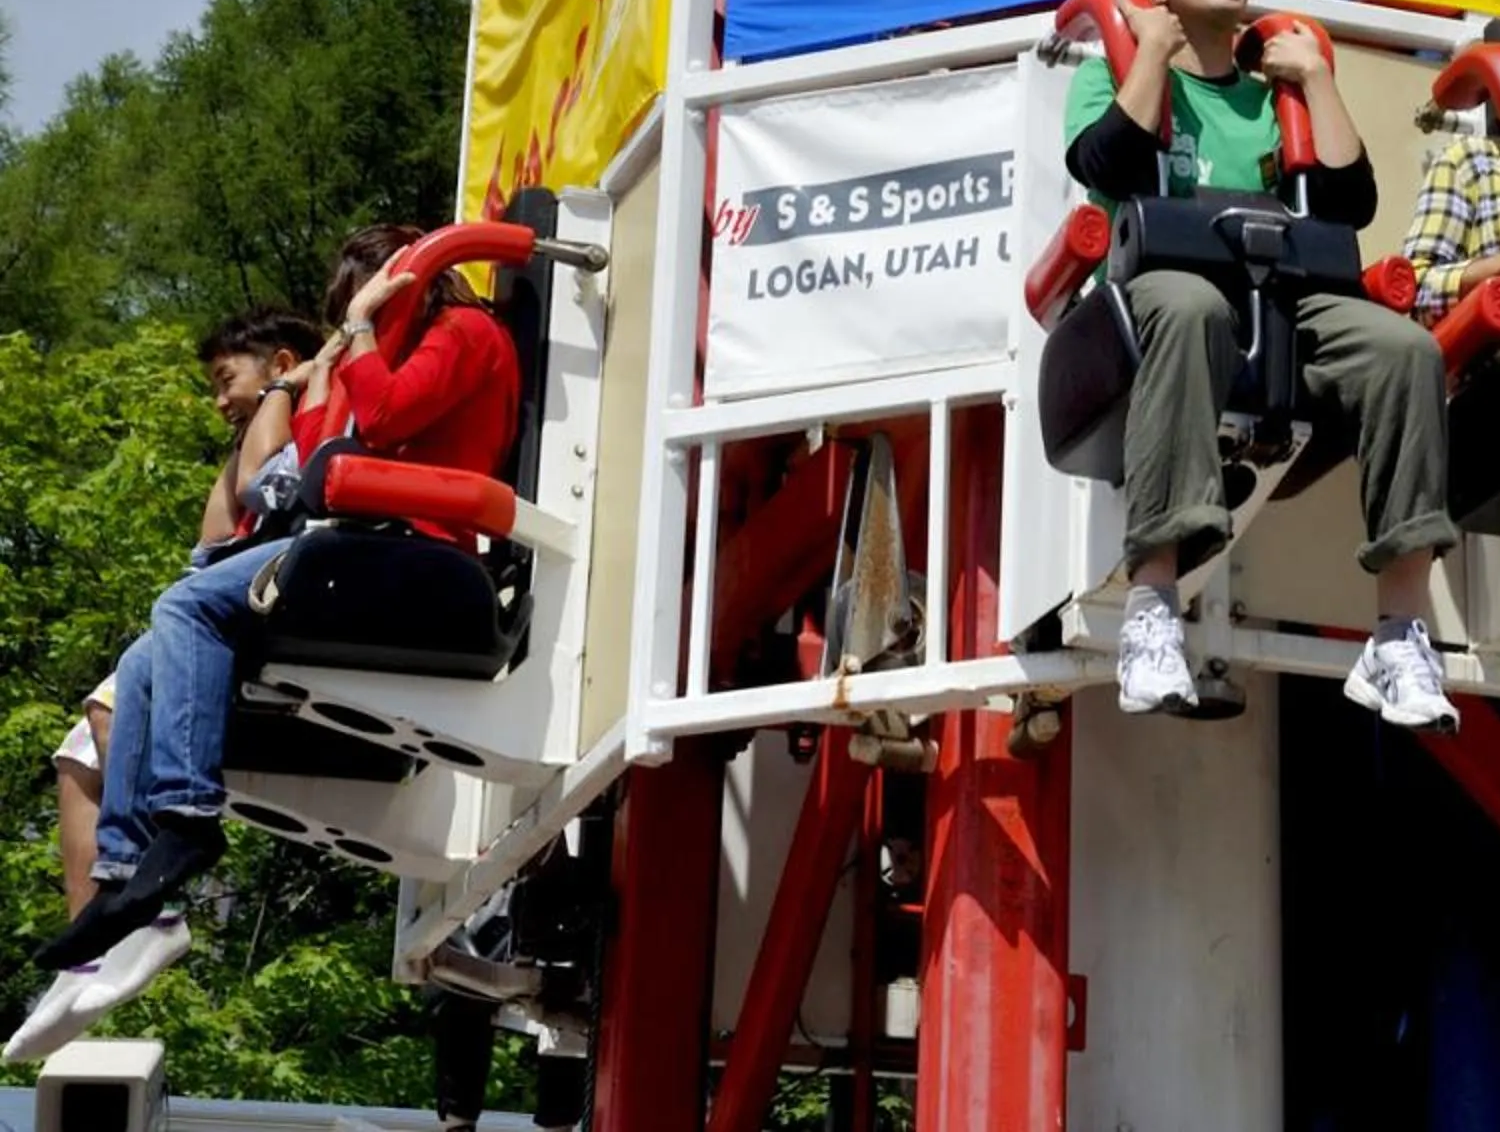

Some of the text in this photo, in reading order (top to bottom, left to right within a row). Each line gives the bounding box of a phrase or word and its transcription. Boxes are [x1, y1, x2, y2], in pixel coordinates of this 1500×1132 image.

[776, 193, 798, 231] S
[808, 194, 835, 226] &
[849, 186, 871, 223] S
[881, 172, 990, 225] Sports
[747, 252, 873, 300] LOGAN,
[885, 237, 979, 278] UTAH
